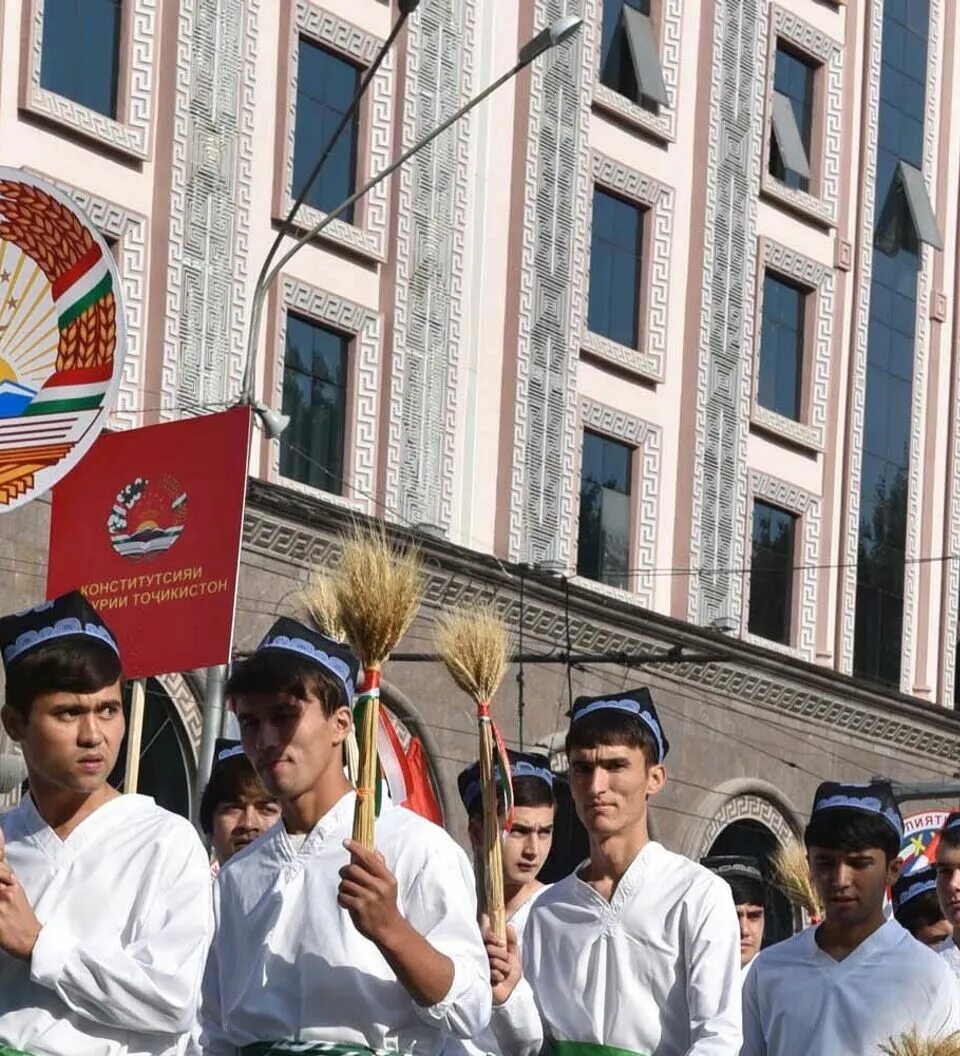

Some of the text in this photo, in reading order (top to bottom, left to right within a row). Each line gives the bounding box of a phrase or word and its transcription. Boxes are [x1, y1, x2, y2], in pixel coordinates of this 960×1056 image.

[80, 565, 203, 597] КОНСТИТУТСИЯИ
[91, 578, 228, 611] УРИИ ТОҶИКИСТОН
[905, 815, 949, 831] ЛИЯТ
